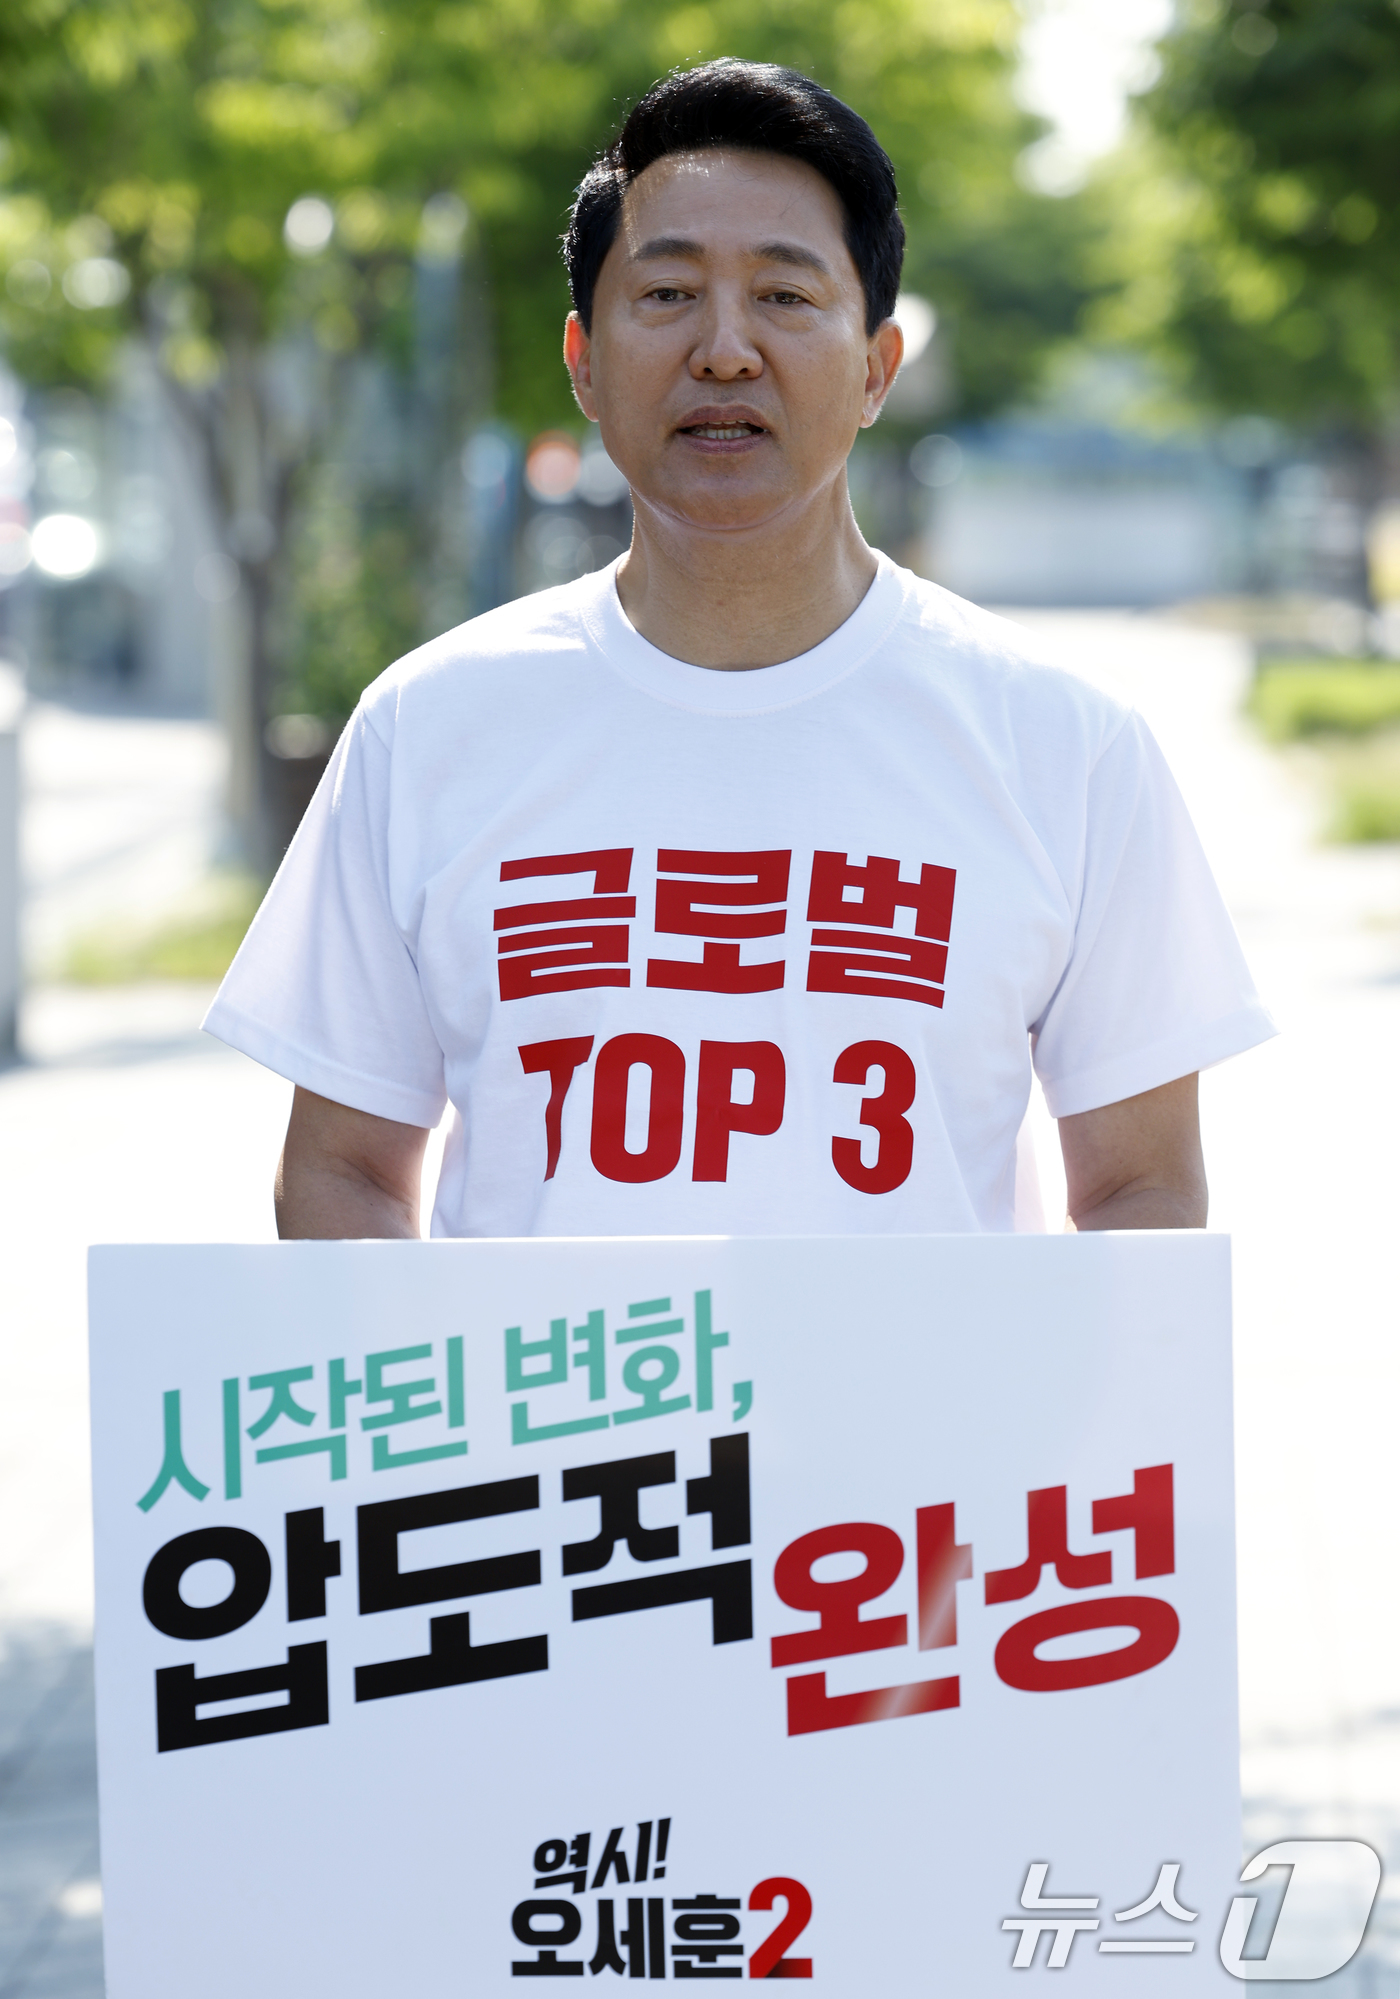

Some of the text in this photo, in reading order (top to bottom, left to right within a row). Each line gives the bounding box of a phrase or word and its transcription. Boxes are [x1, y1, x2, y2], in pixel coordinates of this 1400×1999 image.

[493, 847, 957, 1009] 글로벌
[518, 1032, 916, 1195] TOP 3
[136, 1289, 755, 1514] 시작된 변화,
[142, 1432, 1181, 1754] 압도적 완성
[511, 1876, 814, 1980] 오세훈2
[533, 1817, 672, 1893] 역시!
